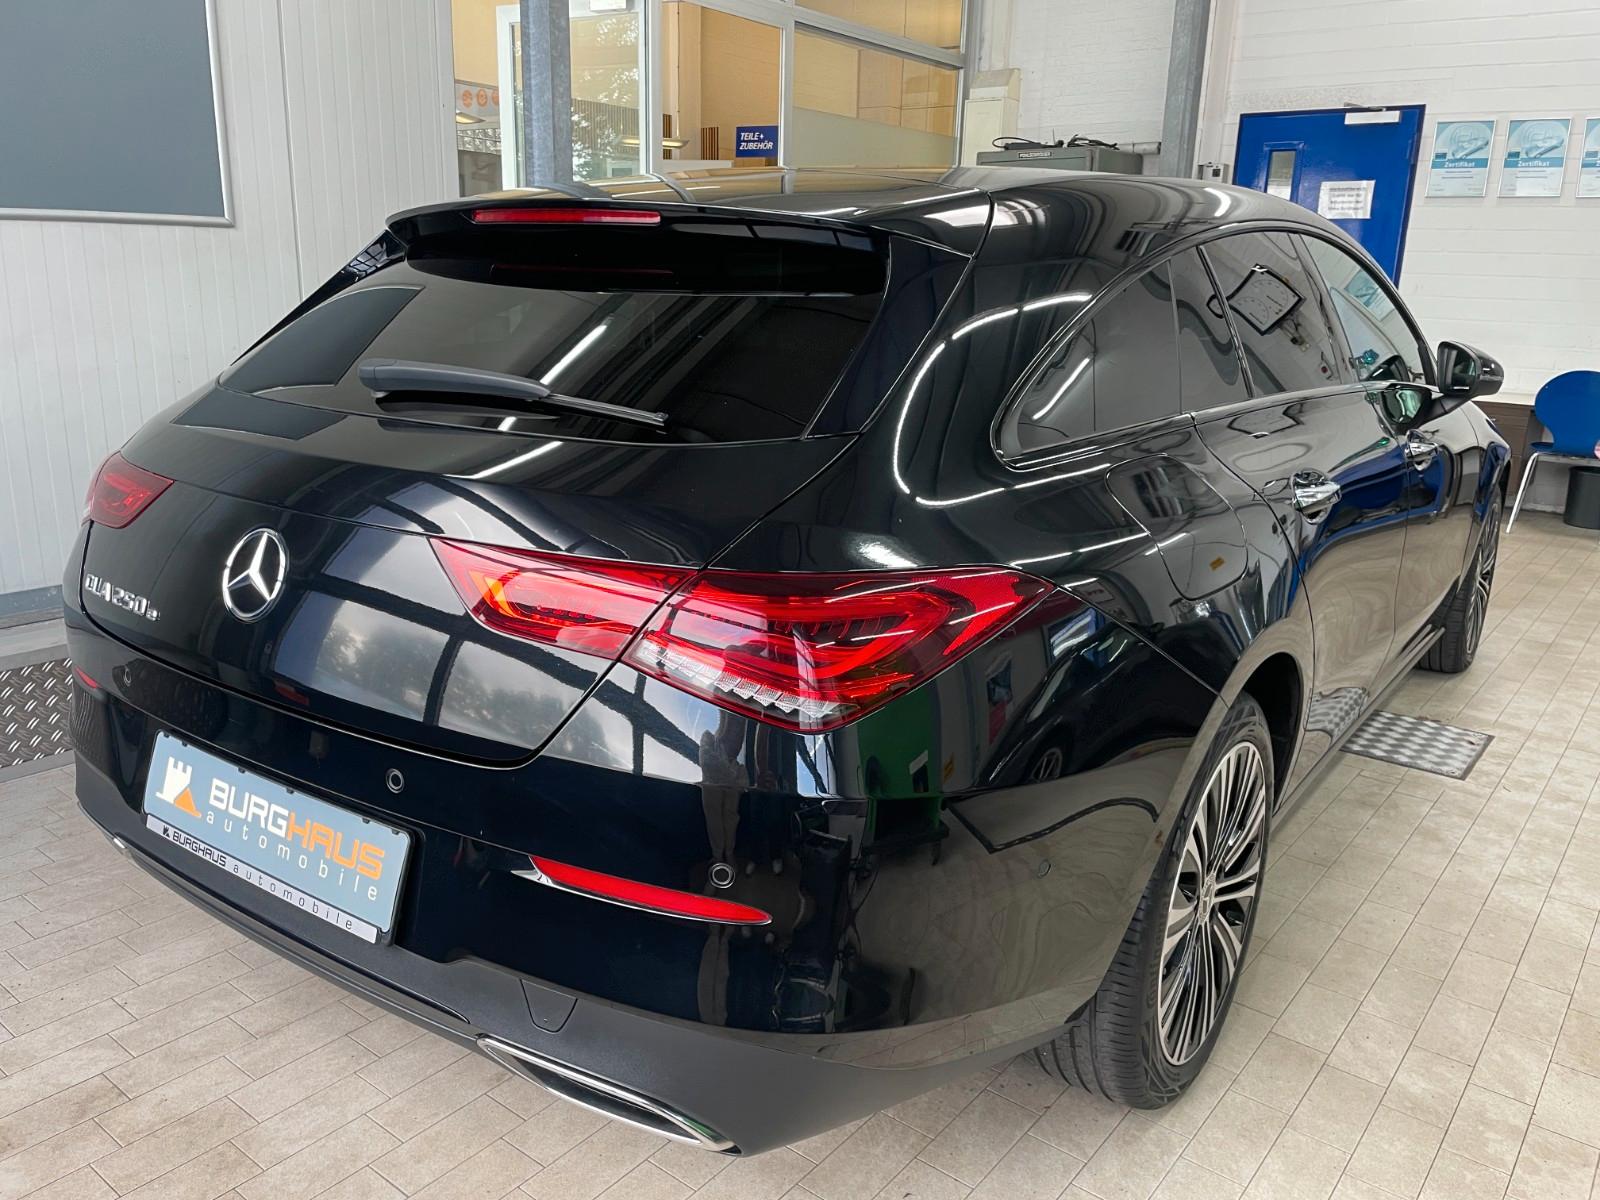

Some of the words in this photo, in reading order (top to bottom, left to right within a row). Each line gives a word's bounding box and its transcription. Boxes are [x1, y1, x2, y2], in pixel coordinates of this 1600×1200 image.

[739, 141, 774, 150] ZUBEHÖR
[1517, 160, 1550, 168] Zertifikat
[84, 574, 111, 602] CLA
[112, 587, 147, 616] 250
[206, 810, 378, 901] automobile
[208, 778, 385, 881] BURGHAUS
[172, 831, 227, 867] BURGHAUS
[233, 863, 353, 930] automobile
